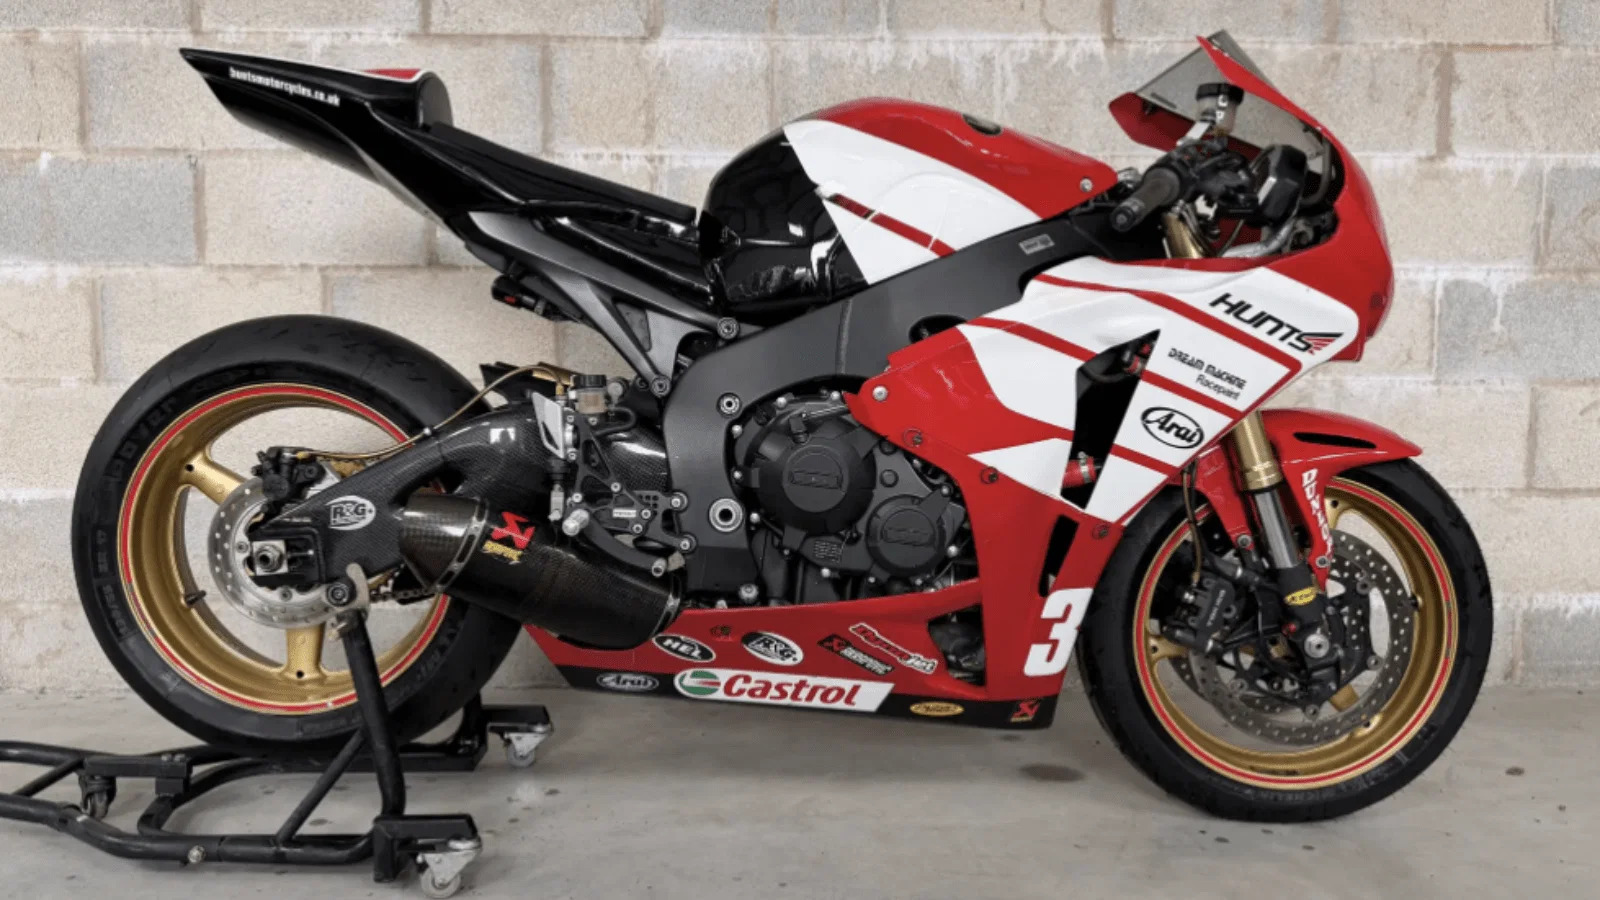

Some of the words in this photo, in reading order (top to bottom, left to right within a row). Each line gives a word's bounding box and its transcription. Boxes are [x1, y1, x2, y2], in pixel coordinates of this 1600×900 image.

[228, 66, 341, 107] huntsmotorcycles.co.uk
[1209, 293, 1320, 352] HUNTS
[1168, 347, 1205, 371] DREAM
[1144, 411, 1199, 443] Arai
[1023, 587, 1094, 677] 3
[723, 674, 862, 706] Castrol
